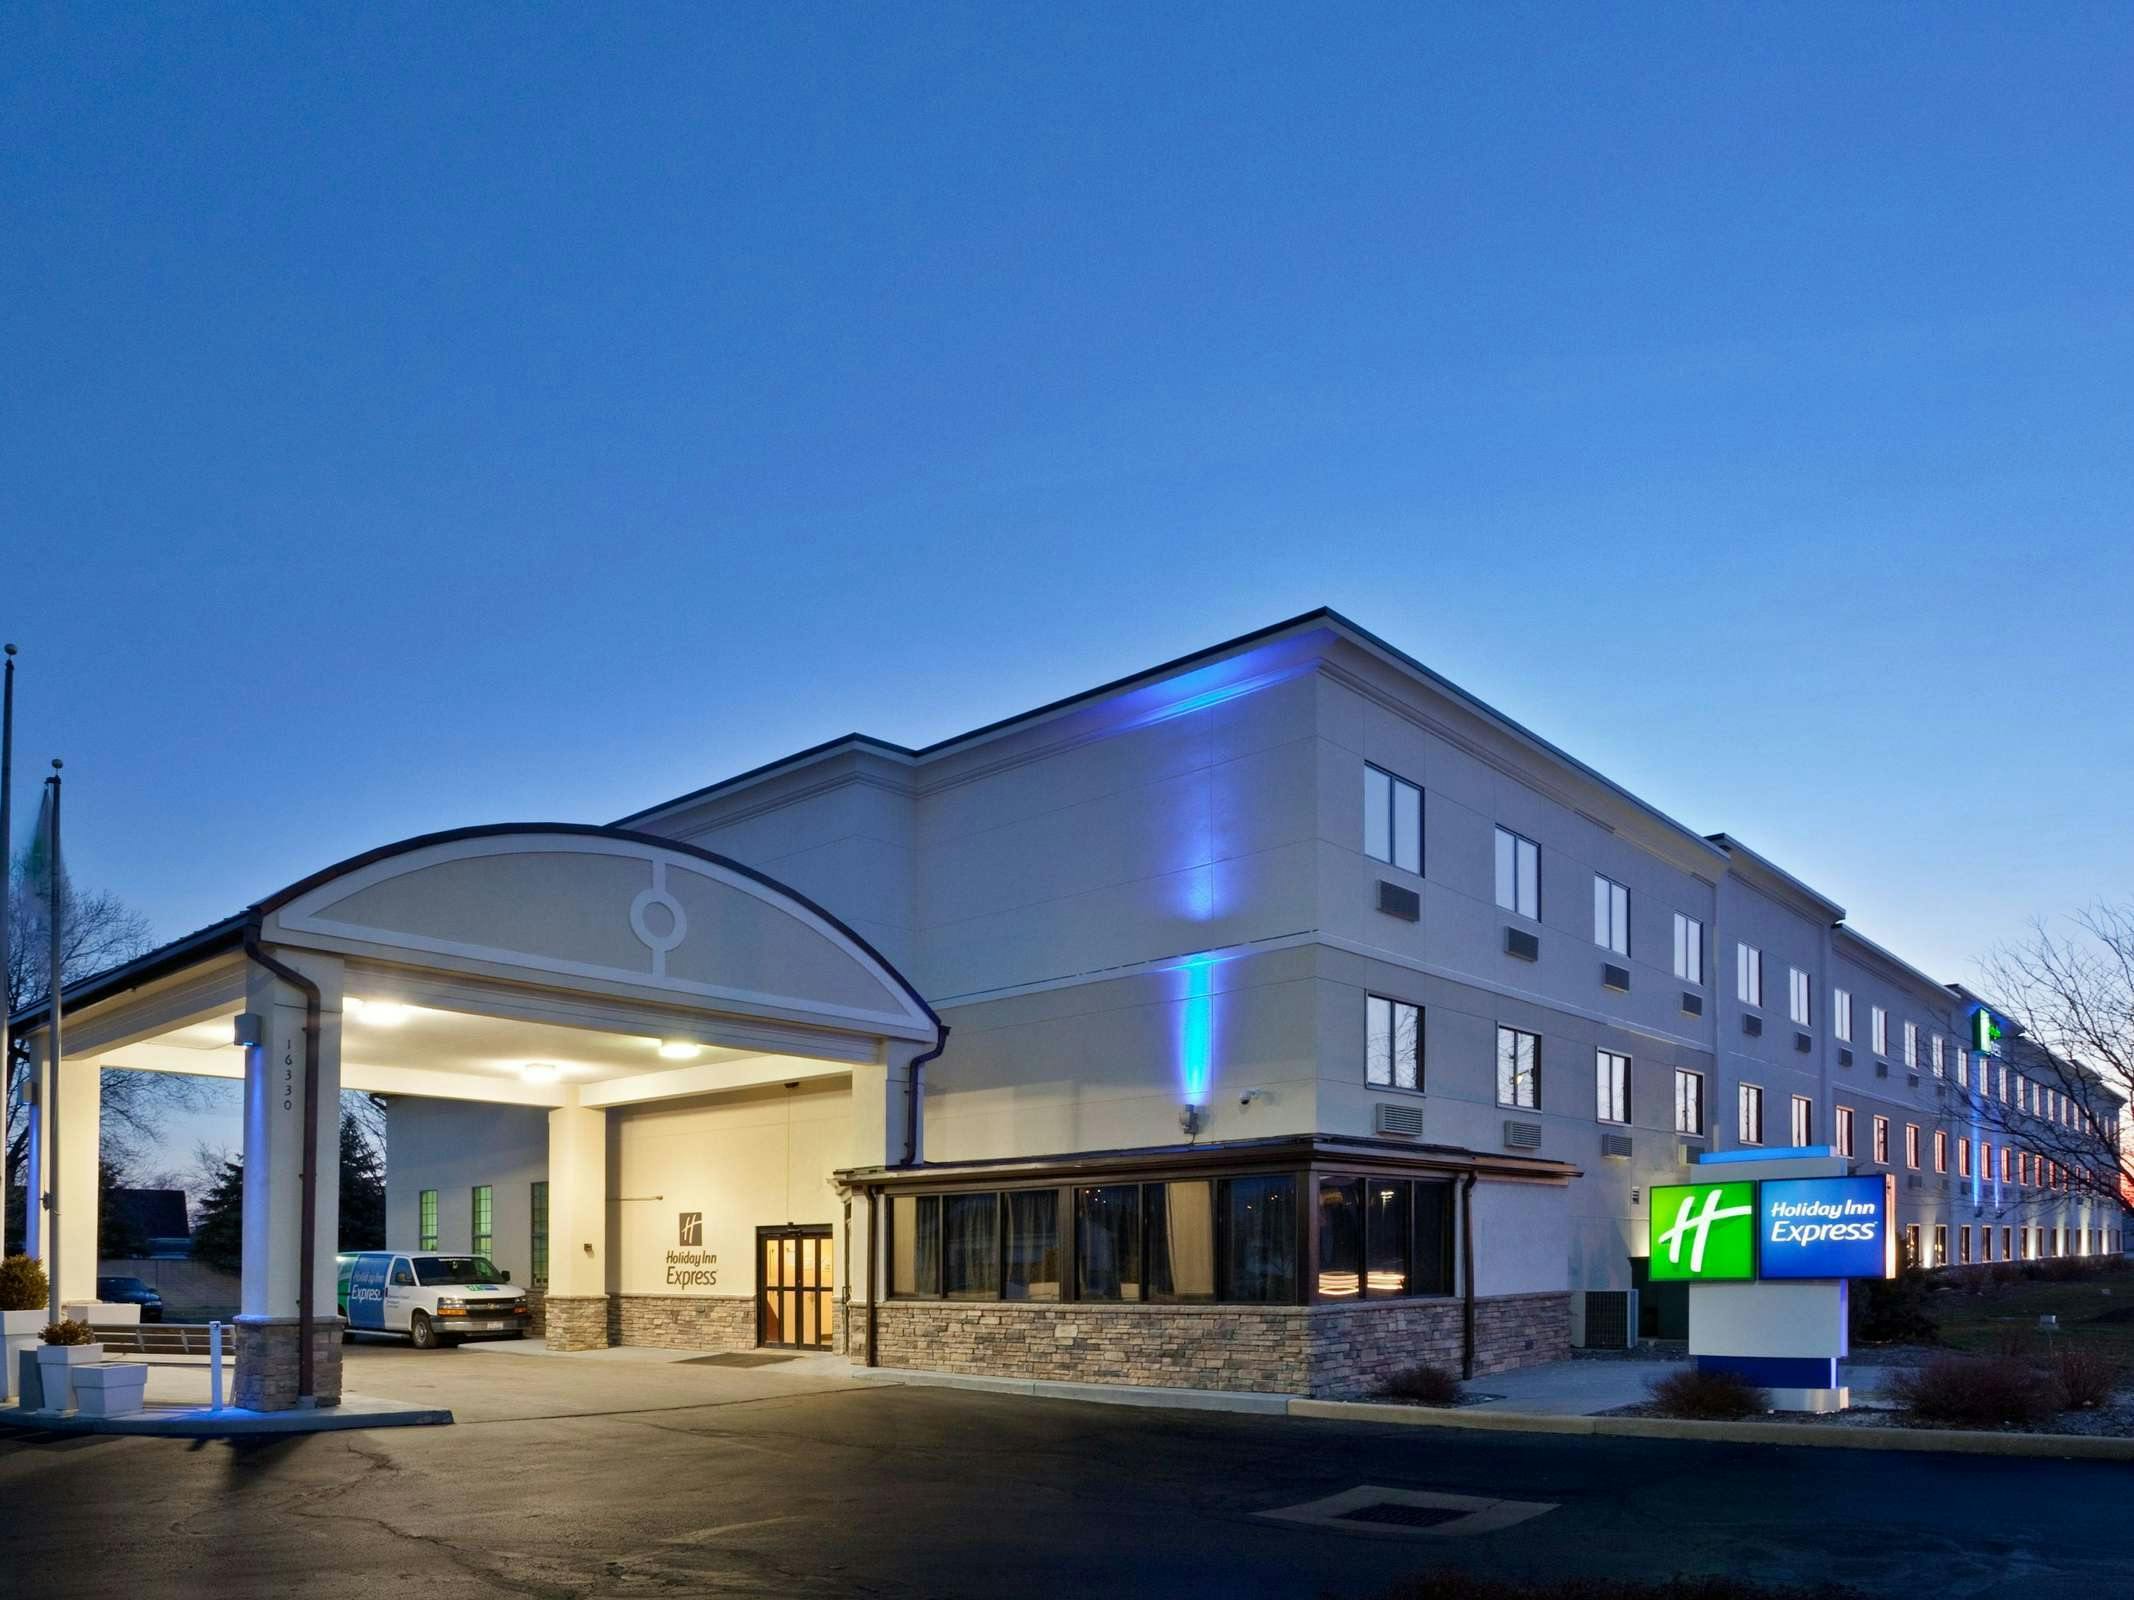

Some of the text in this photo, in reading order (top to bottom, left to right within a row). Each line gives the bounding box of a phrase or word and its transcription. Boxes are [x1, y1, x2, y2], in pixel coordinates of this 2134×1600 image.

[284, 1039, 293, 1111] 16330
[1770, 1199, 1875, 1219] Holiday Inn
[1770, 1220, 1875, 1247] Express
[666, 1250, 717, 1267] Holiday Inn
[666, 1266, 717, 1290] Express
